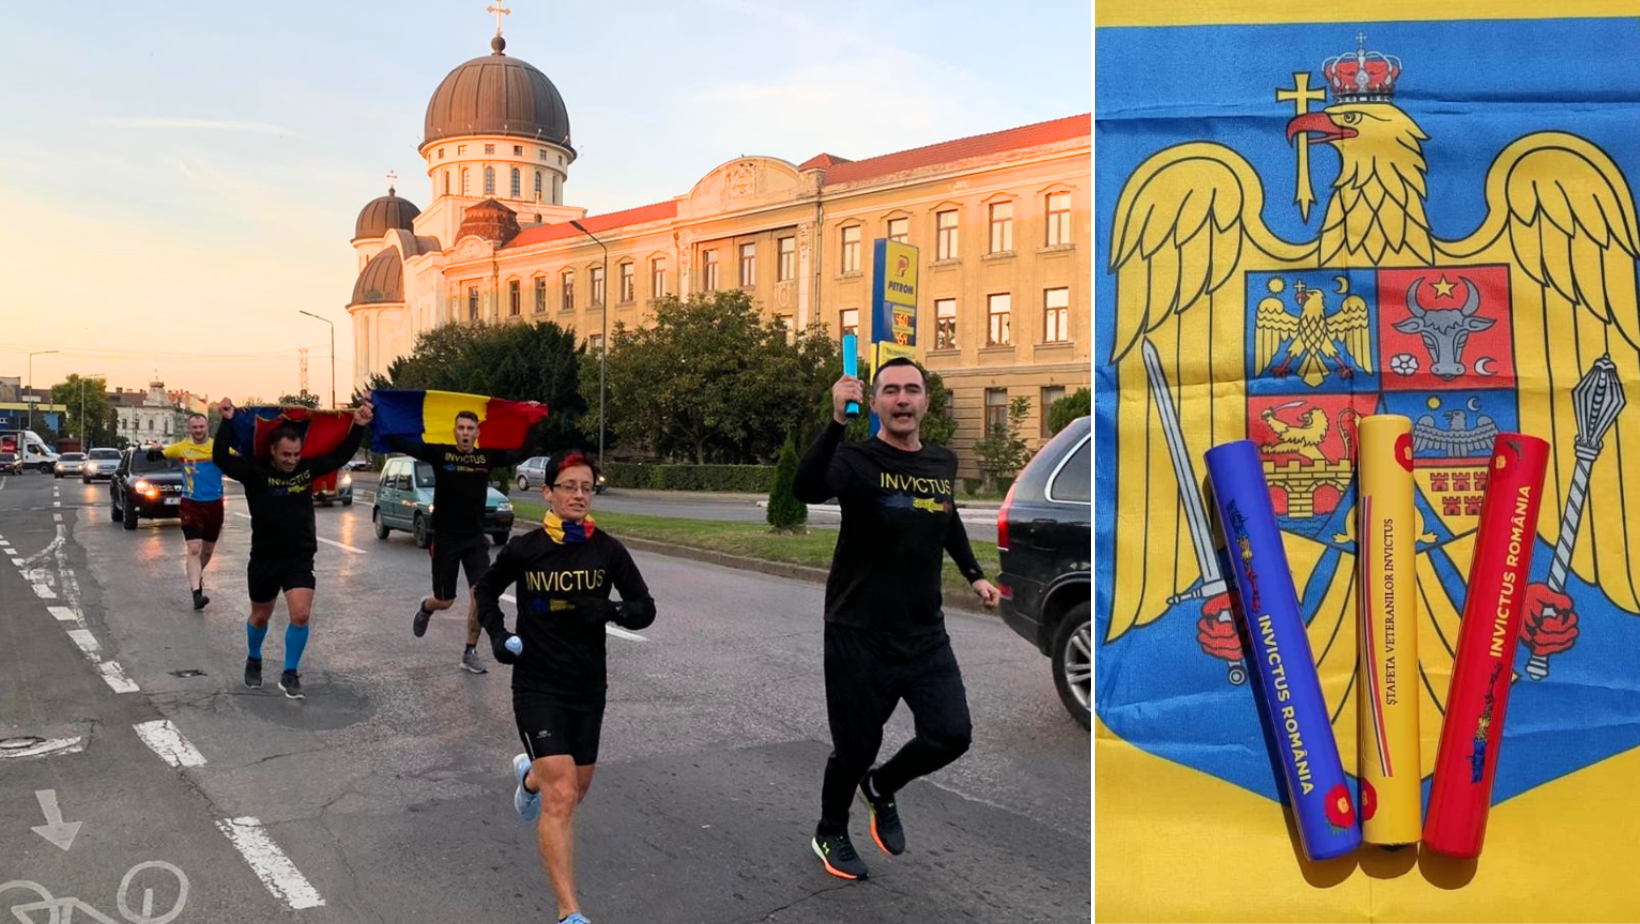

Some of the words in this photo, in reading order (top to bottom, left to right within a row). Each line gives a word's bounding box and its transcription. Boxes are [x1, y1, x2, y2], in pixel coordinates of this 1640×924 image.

[888, 280, 914, 295] PETROM
[445, 452, 487, 464] INVICTUS
[880, 472, 951, 495] INVICTUS
[1383, 518, 1394, 571] INVICTUS
[525, 569, 606, 591] INVICTUS
[1489, 571, 1517, 657] INVICTUS
[1506, 486, 1531, 567] ROMÂNIA
[1384, 574, 1395, 653] VETERANILOR
[1257, 614, 1290, 702] INVICTUS
[1281, 705, 1314, 795] ROMÂNIA
